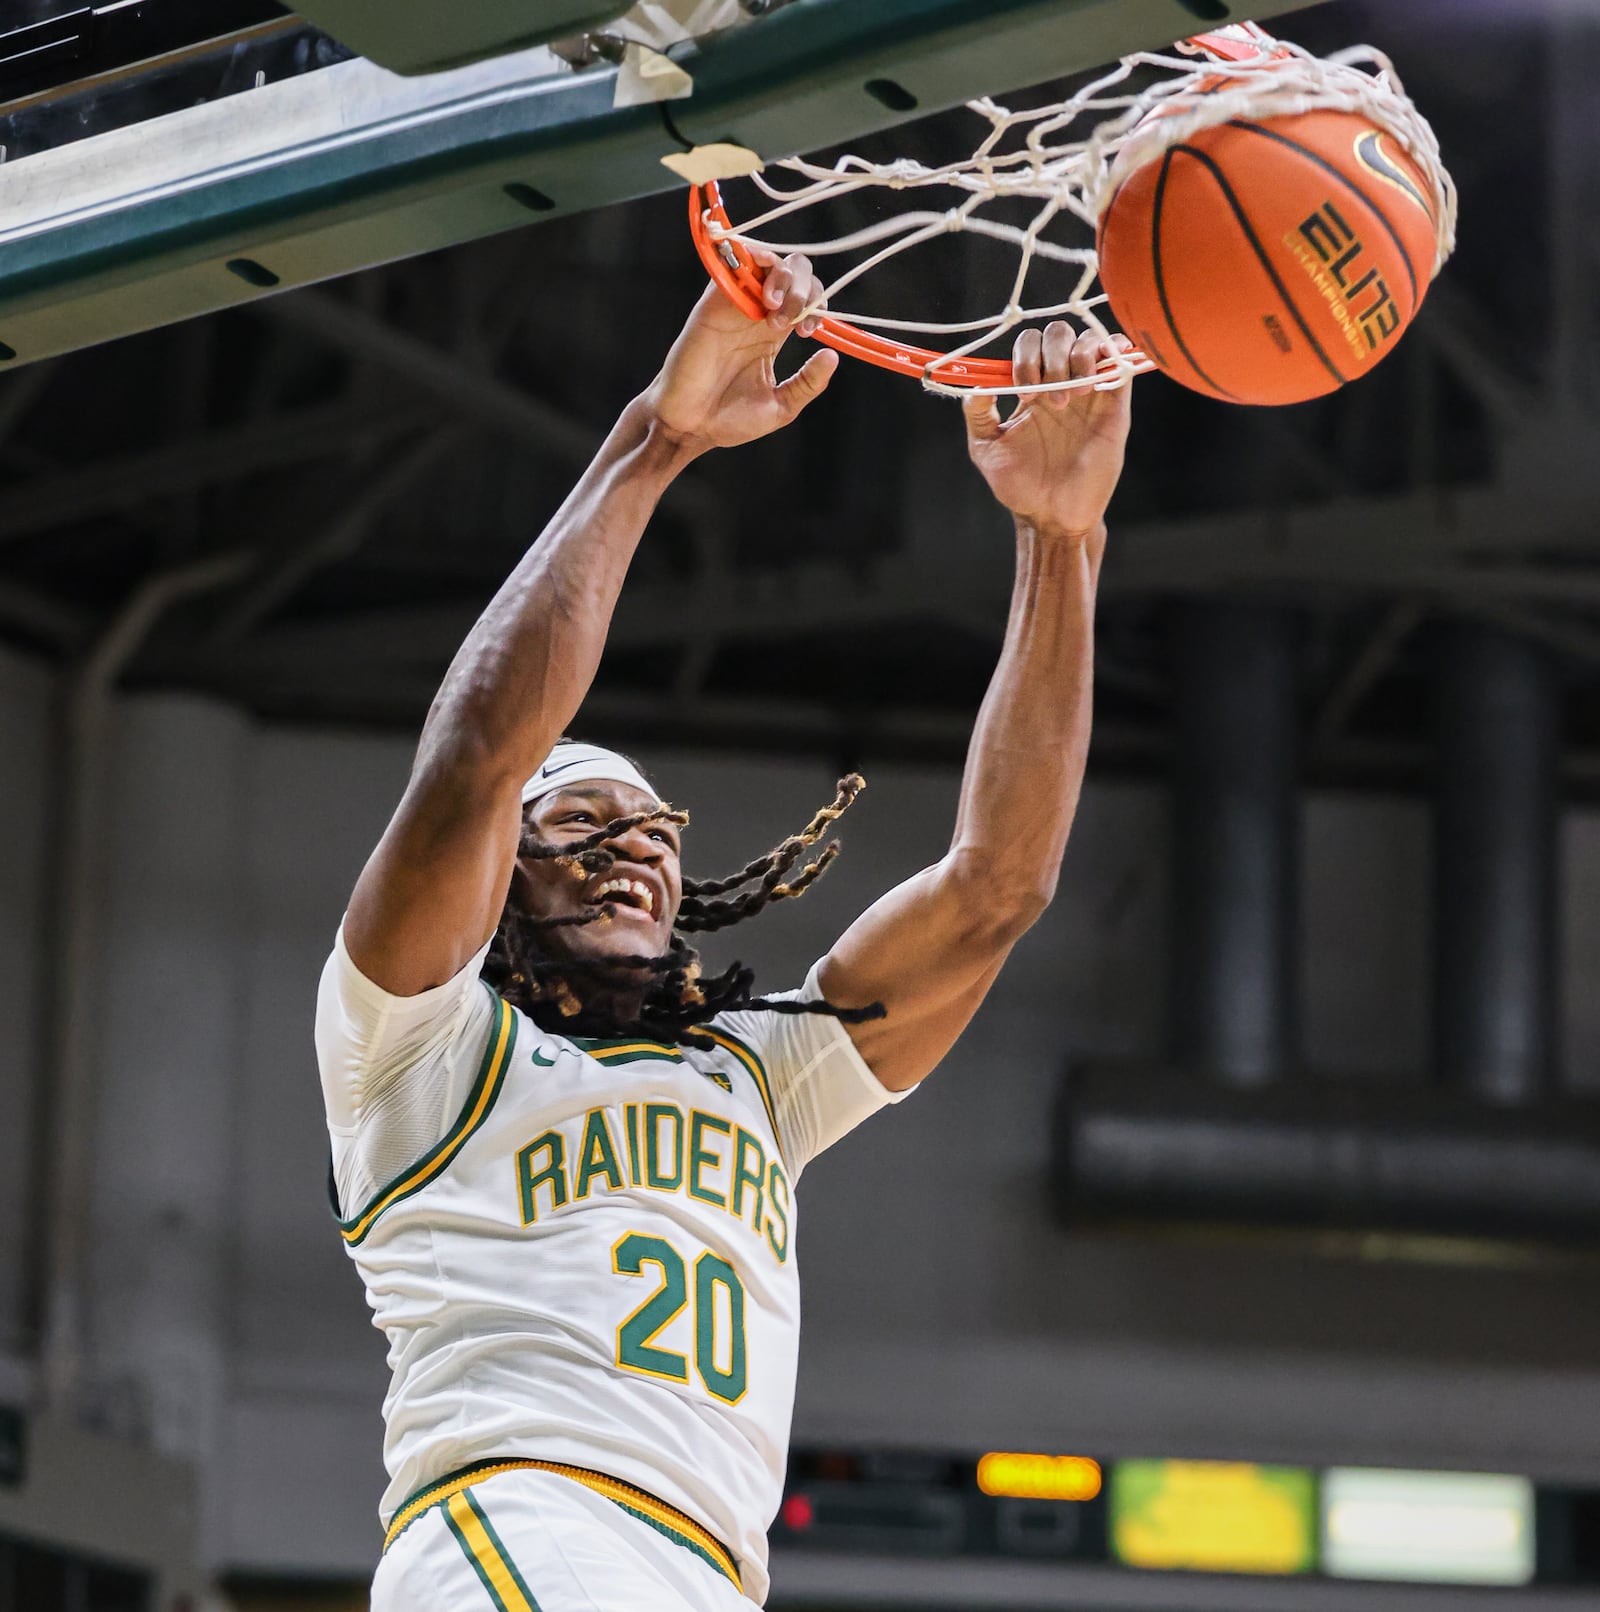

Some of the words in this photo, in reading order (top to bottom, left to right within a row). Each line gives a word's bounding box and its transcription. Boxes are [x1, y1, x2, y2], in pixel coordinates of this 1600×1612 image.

[1298, 201, 1400, 350] ELITE
[515, 1102, 789, 1266] RAIDERS
[611, 1230, 748, 1406] 20
